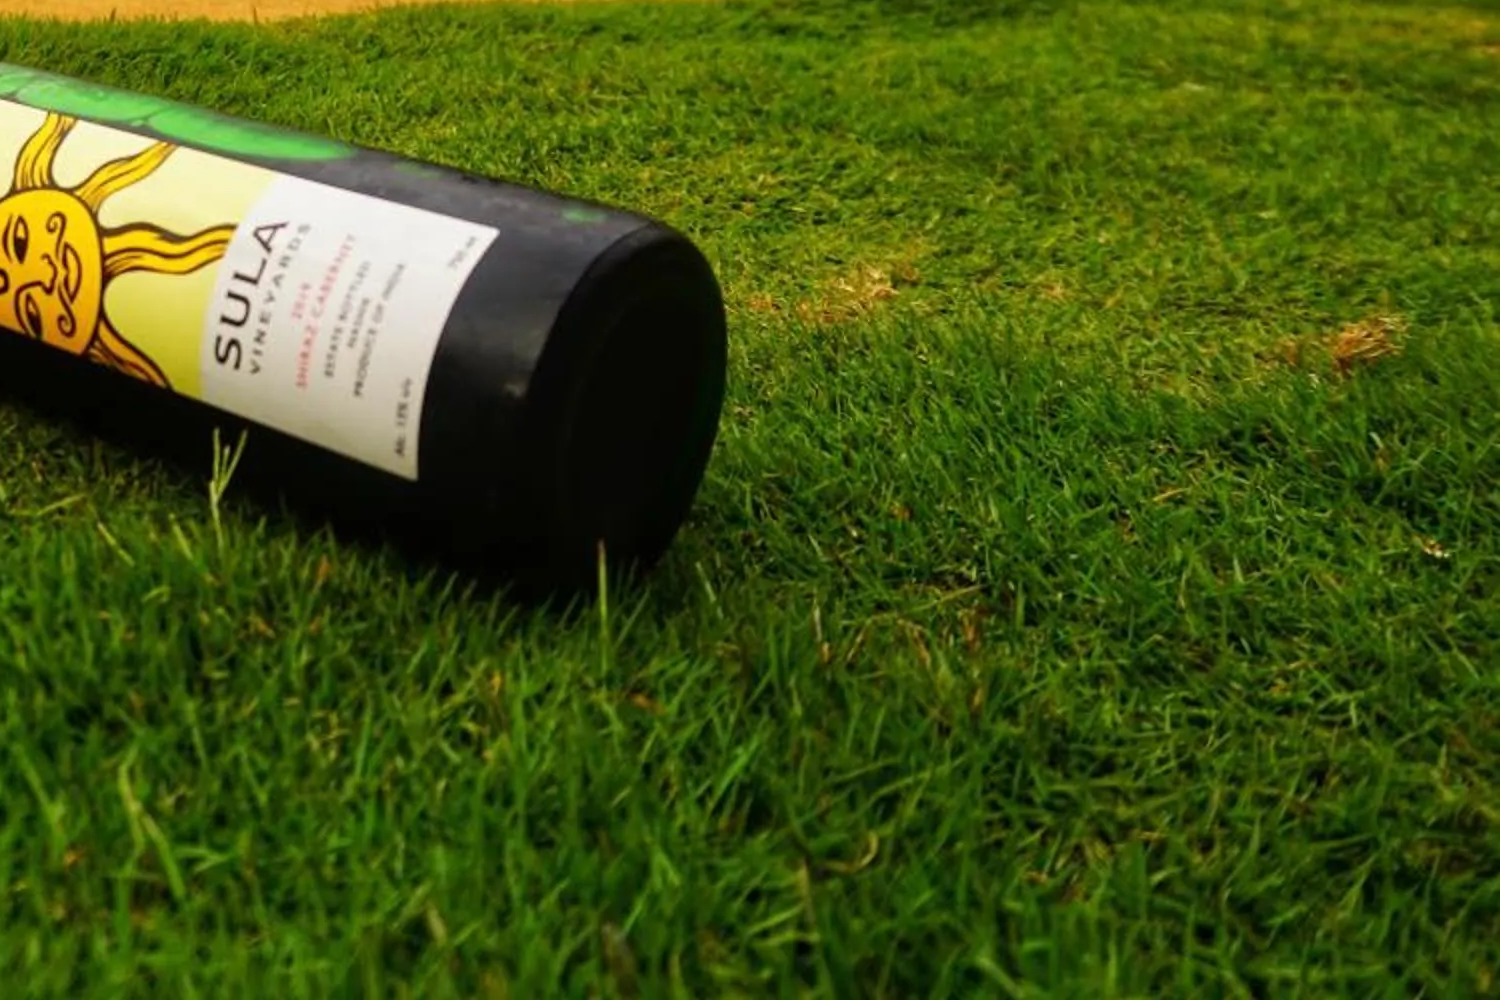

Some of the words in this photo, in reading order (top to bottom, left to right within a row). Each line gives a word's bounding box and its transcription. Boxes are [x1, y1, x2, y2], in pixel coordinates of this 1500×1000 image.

[214, 221, 290, 371] SULA
[249, 223, 311, 376] VINEYARDS
[295, 325, 318, 389] SHIRAZ
[311, 233, 357, 319] CABERNET
